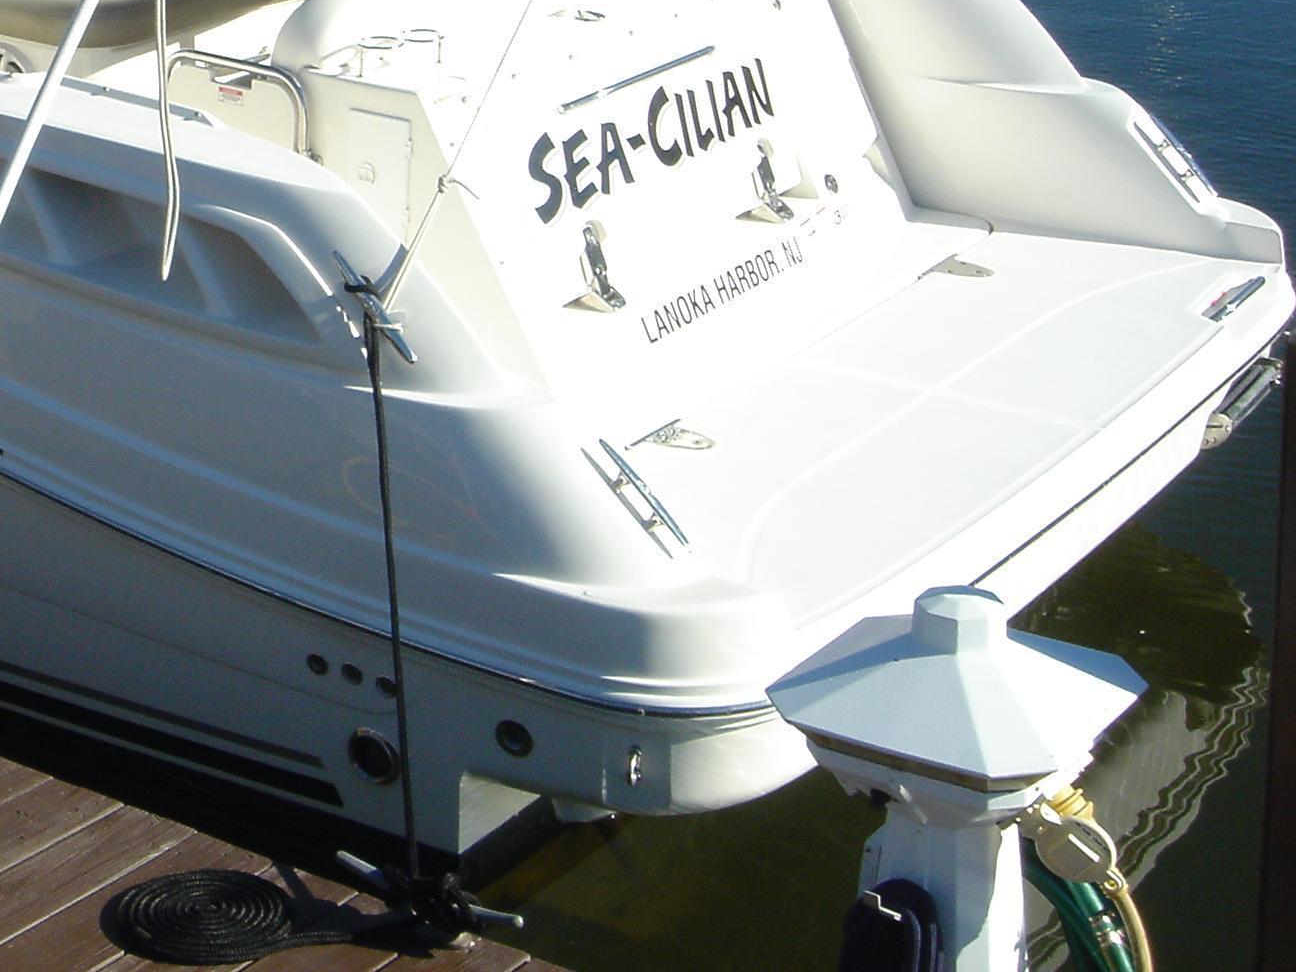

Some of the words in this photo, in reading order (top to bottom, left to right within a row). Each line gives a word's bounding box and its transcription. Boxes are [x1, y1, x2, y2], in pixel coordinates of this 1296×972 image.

[528, 58, 774, 224] SEA-CILIAN
[641, 285, 716, 343] LANOKA
[781, 236, 803, 267] NJ
